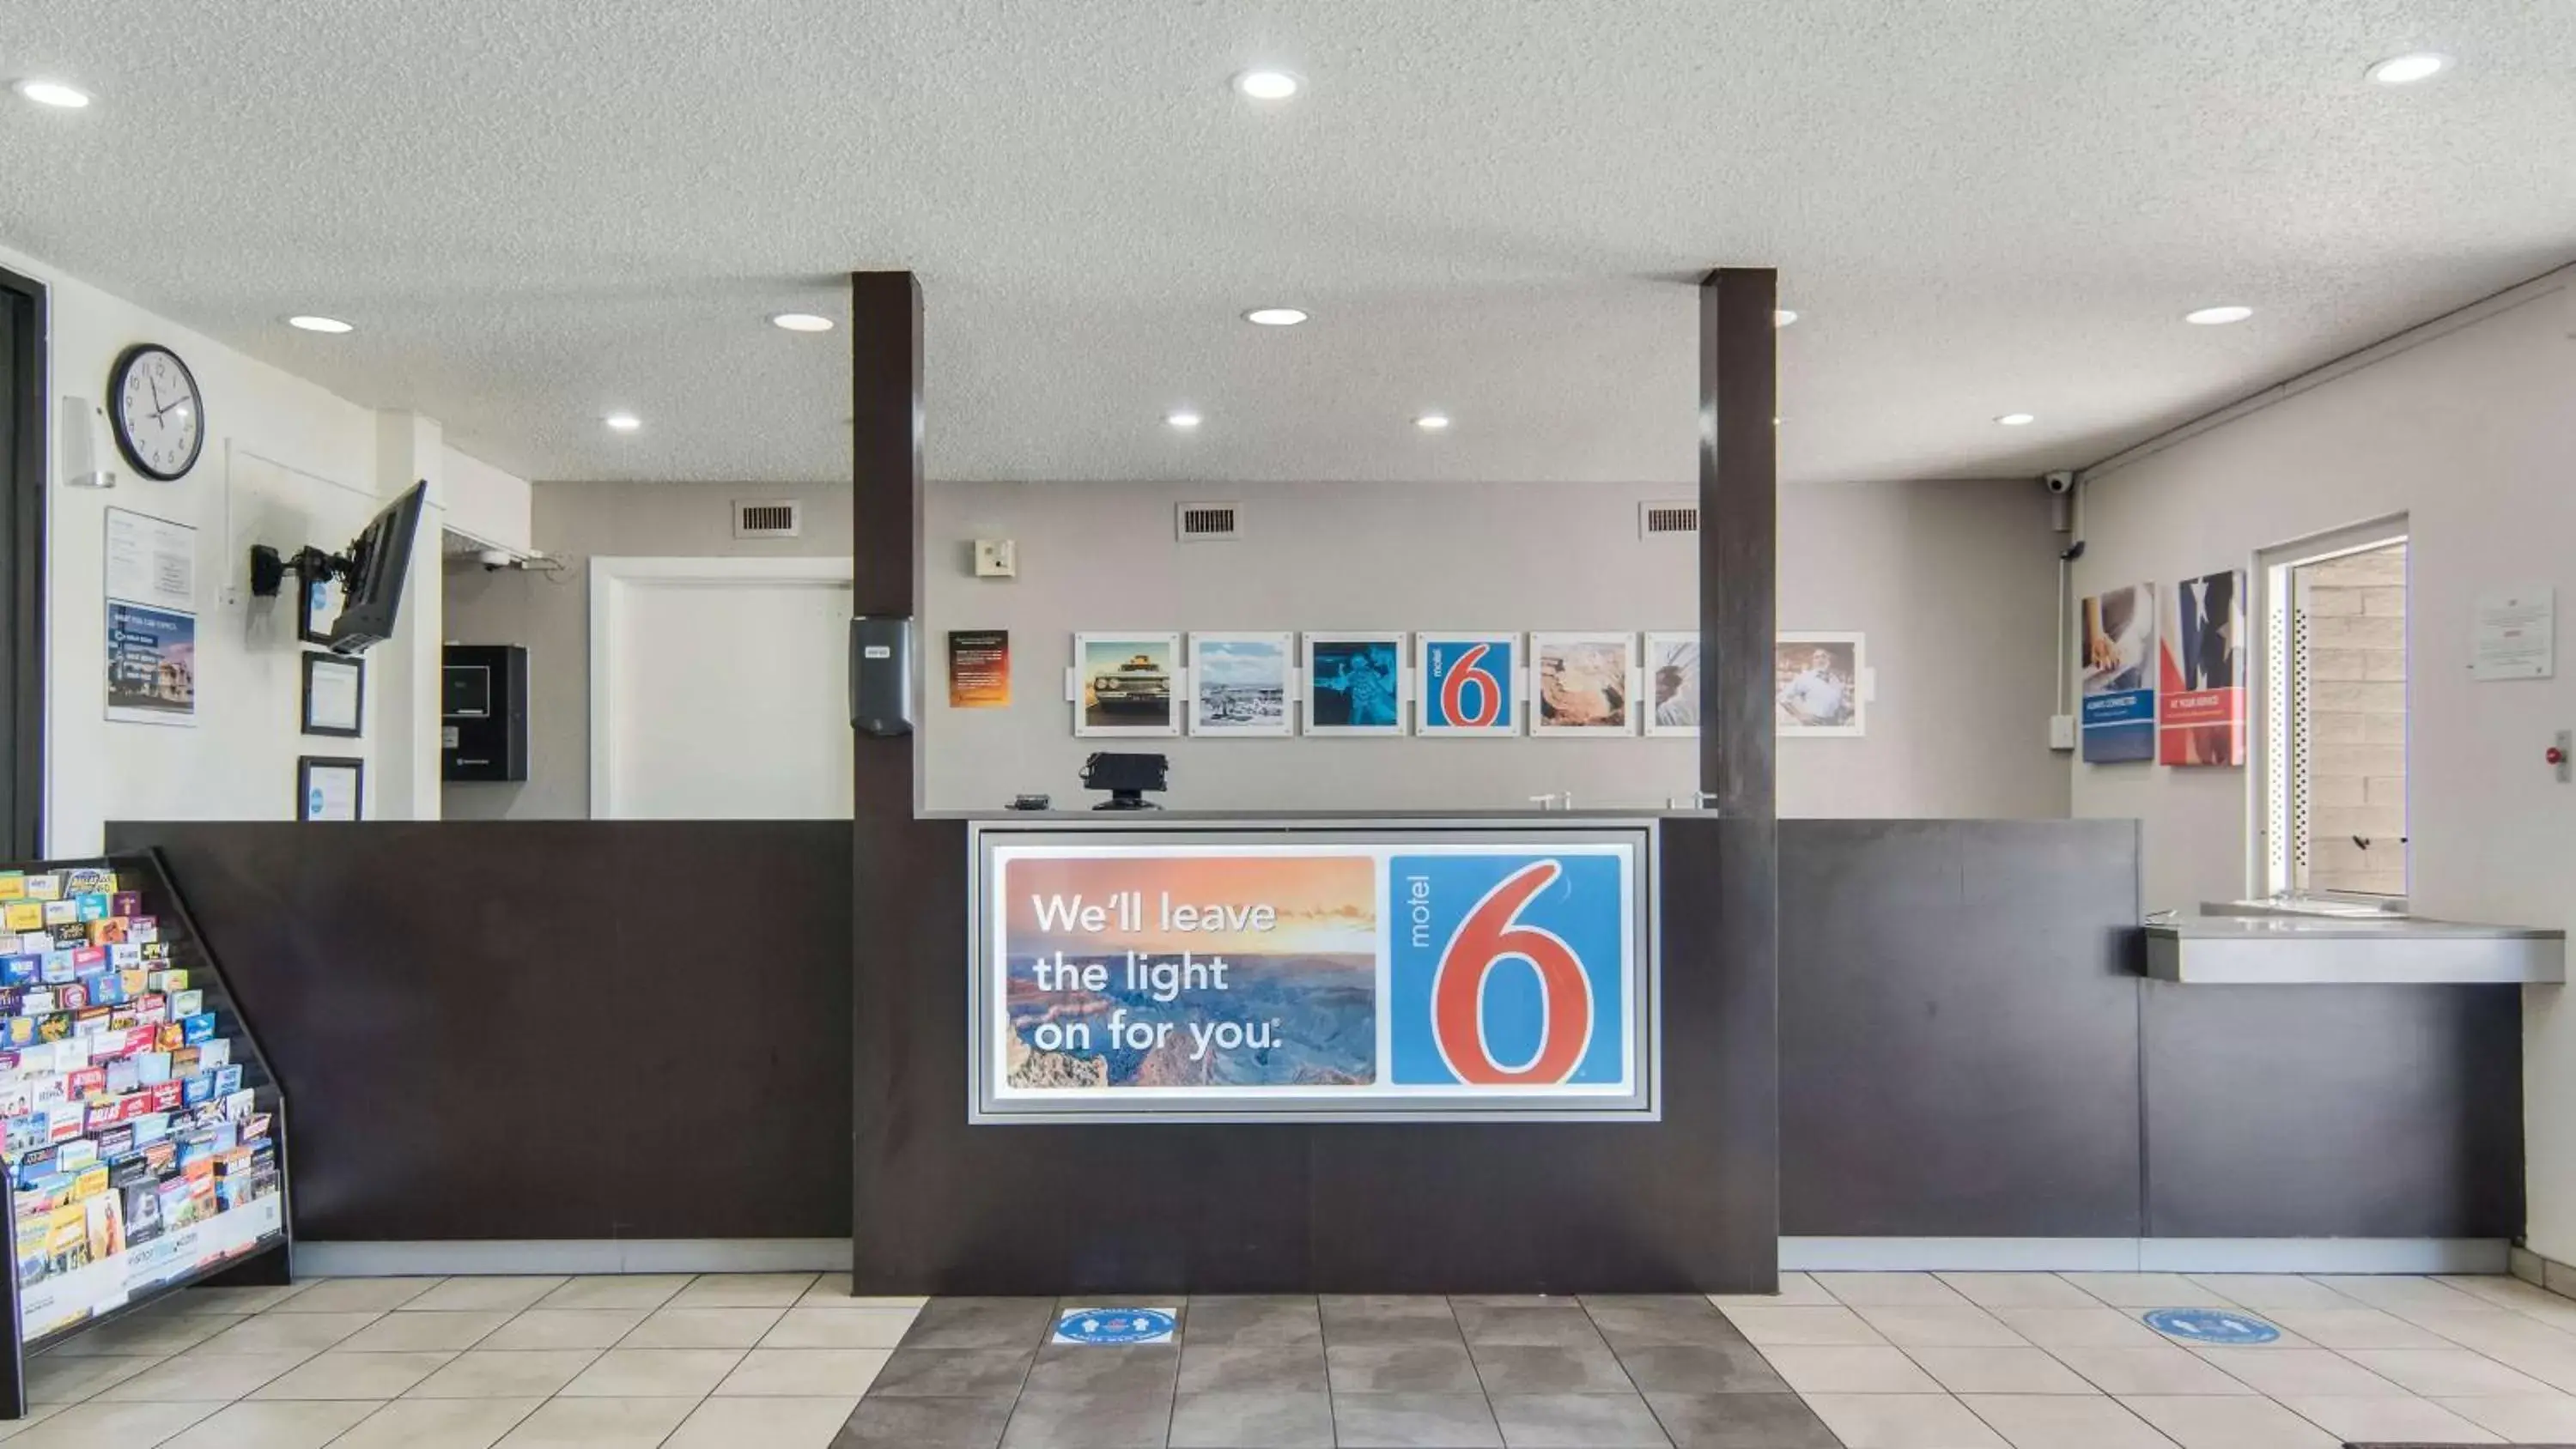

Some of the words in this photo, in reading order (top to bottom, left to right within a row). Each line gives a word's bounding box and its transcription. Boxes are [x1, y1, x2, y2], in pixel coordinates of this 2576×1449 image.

[1441, 643, 1501, 726] 6
[1032, 892, 1143, 933] We’ll
[1161, 892, 1278, 933] leave
[1406, 876, 1430, 948] motel
[1032, 950, 1109, 991] the
[1126, 949, 1230, 1002] light
[1430, 858, 1595, 1085] 6
[1034, 1022, 1090, 1051] on
[1107, 1009, 1175, 1051] for
